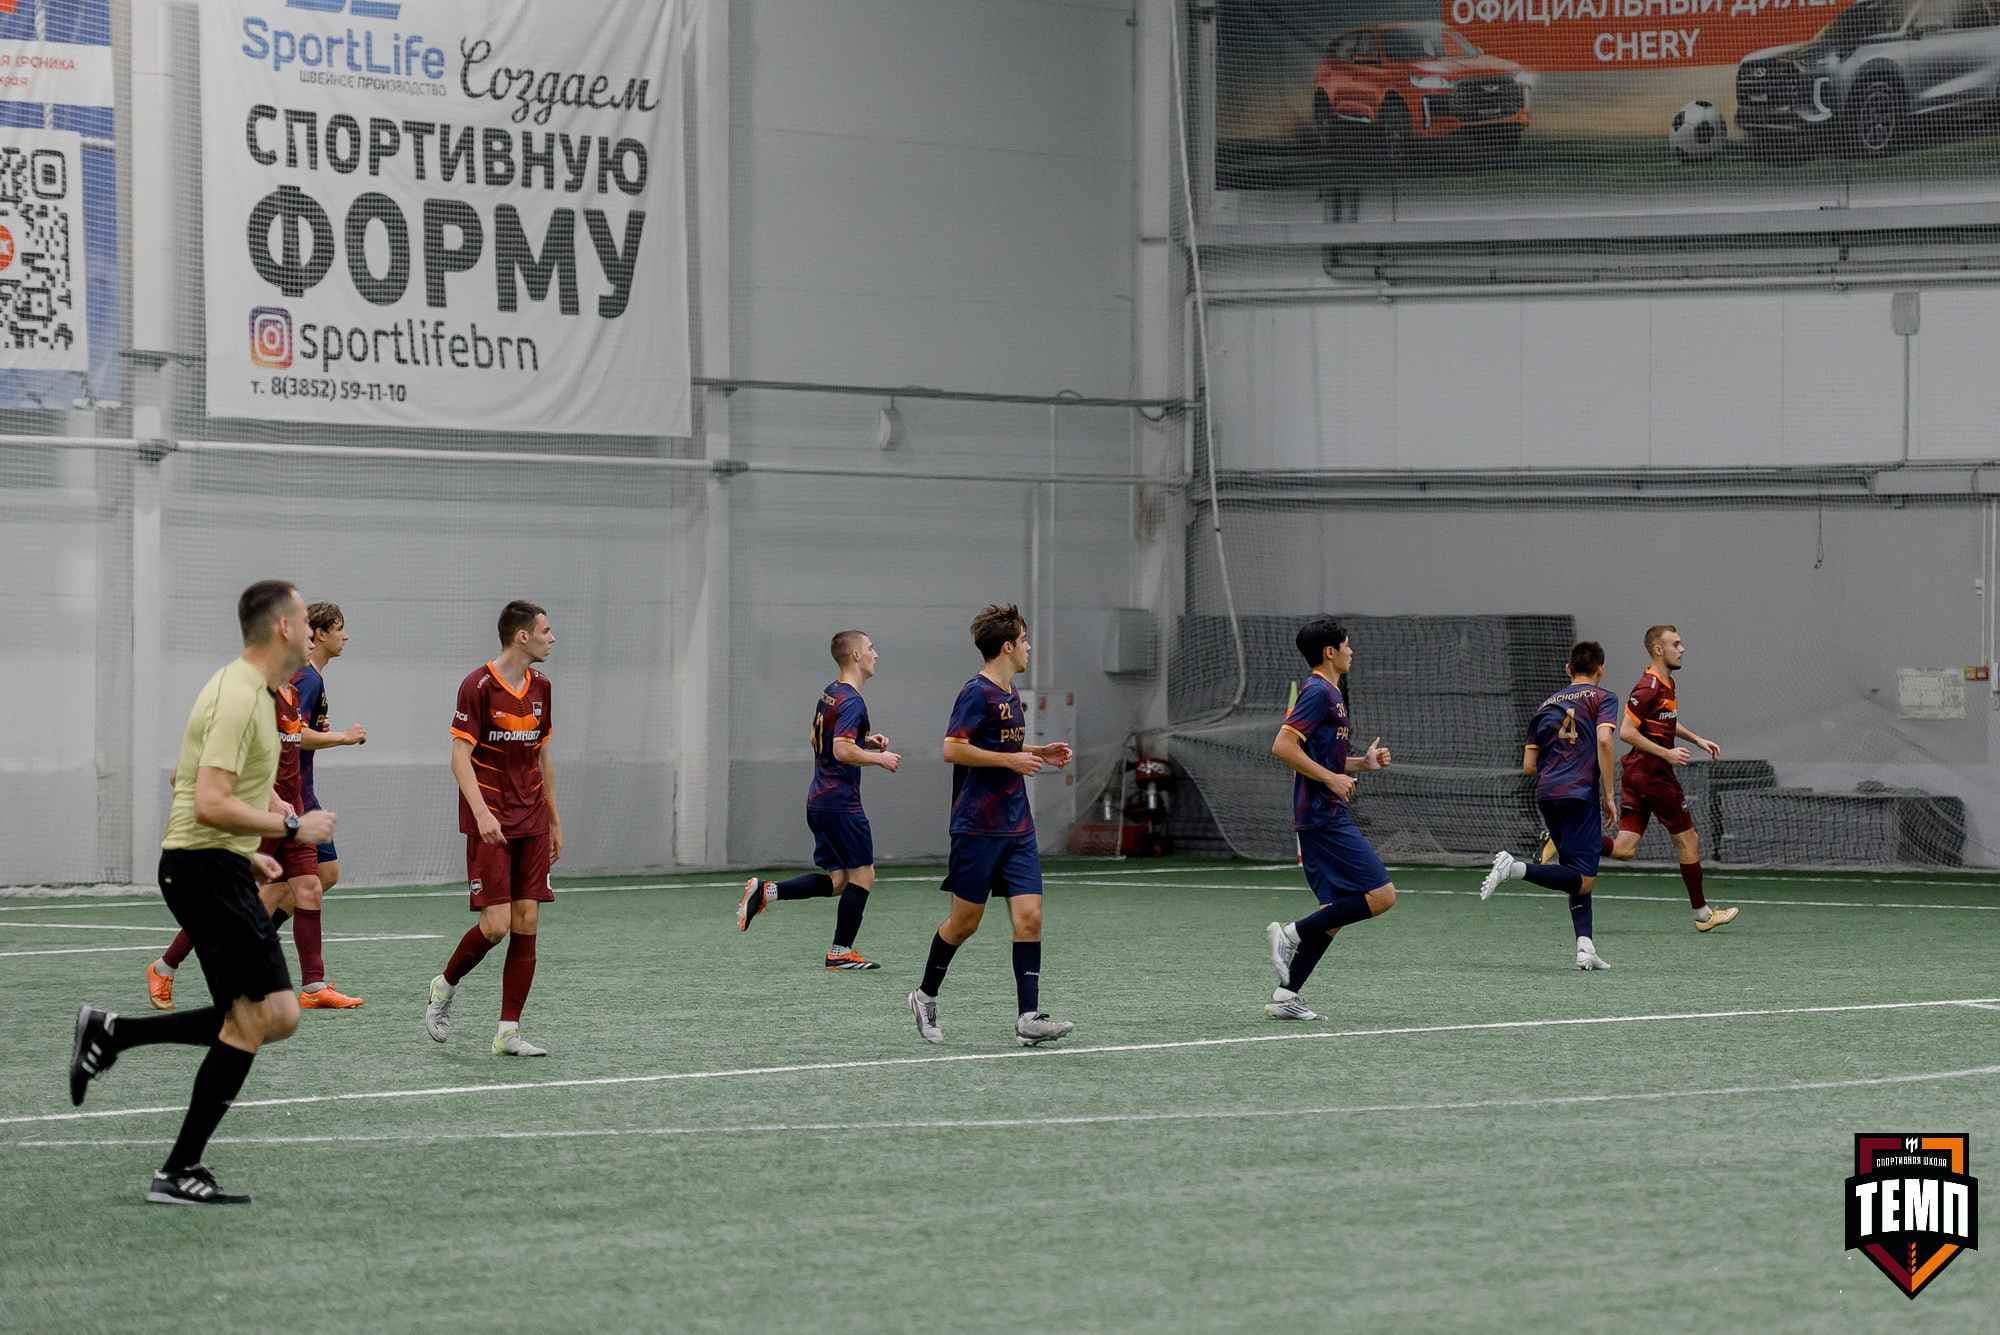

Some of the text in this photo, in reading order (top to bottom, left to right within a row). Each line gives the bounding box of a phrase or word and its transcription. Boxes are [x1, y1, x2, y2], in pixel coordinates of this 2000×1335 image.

[242, 16, 445, 79] SportLife
[1594, 27, 1700, 61] CHERY
[357, 76, 448, 97] ПРОИЗВОДСТВО
[460, 37, 659, 125] Создаем
[245, 103, 649, 196] СПОРТИВНУЮ
[247, 185, 646, 319] ФОРМУ
[299, 318, 539, 372] sportlifebrn
[271, 376, 336, 402] 8(3852)
[340, 382, 407, 402] 59-11-10
[1558, 708, 1579, 745] 4
